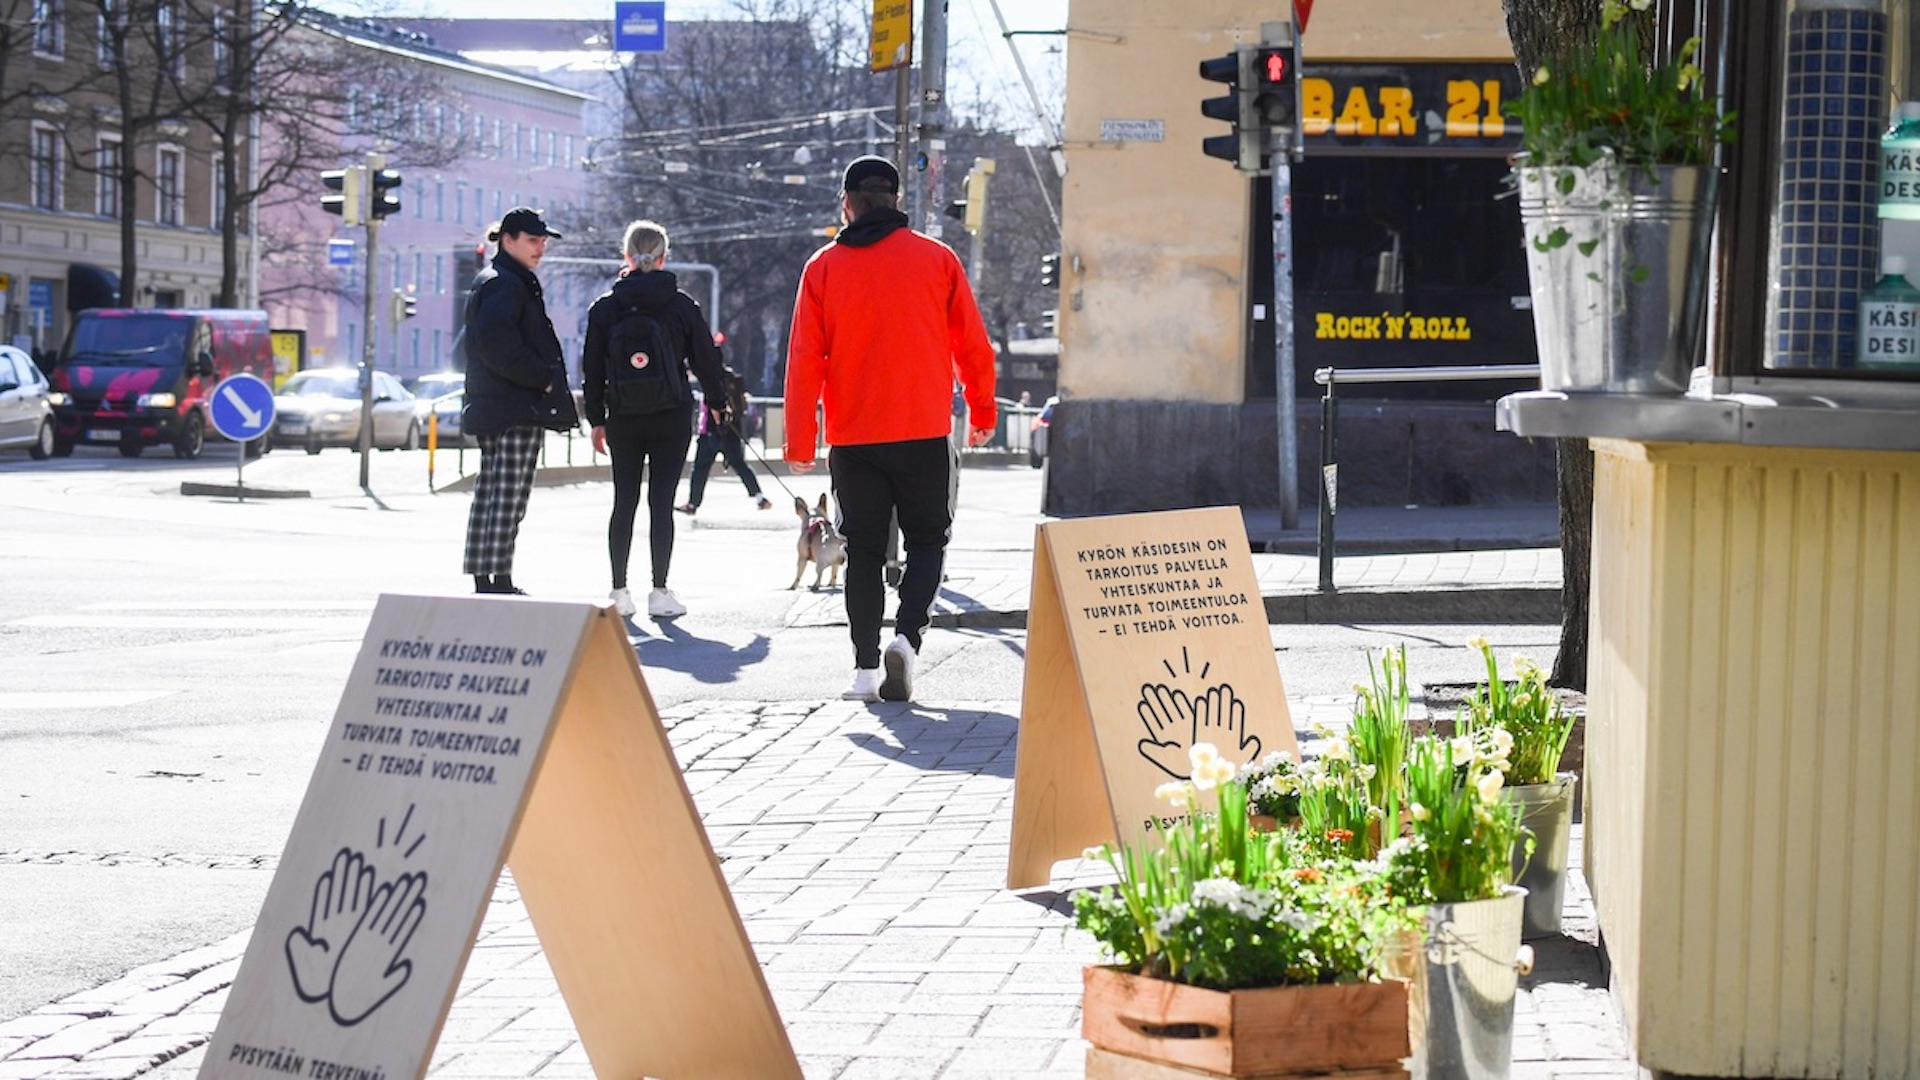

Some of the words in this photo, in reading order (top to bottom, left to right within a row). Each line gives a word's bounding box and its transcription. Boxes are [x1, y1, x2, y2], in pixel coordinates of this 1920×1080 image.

[1302, 78, 1417, 135] BAR
[1446, 80, 1505, 137] 21
[1869, 304, 1916, 328] KÄSI
[1868, 337, 1915, 354] DESI
[1077, 544, 1126, 563] KYRÖN
[1132, 541, 1201, 558] KÄSIDESIN
[1207, 538, 1228, 551] ON
[1085, 563, 1159, 581] TARKOITUS
[1165, 557, 1228, 574] PALVELLA
[1100, 579, 1200, 598] YHTEISKUNTAA
[1207, 576, 1223, 589] JA
[1083, 603, 1142, 620] TURVATA
[1148, 593, 1248, 614] TOIMEENTULOA
[1114, 624, 1127, 636] EI
[1133, 614, 1177, 634] TEHDÄ
[1182, 612, 1244, 629] VOITTOA.
[380, 636, 433, 659] KYRÖN
[436, 638, 516, 665] KÄSIDESIN
[521, 649, 547, 667] ON
[375, 668, 453, 691] TARKOITUS
[457, 674, 530, 696] PALVELLA
[375, 697, 482, 723] YHTEISKUNTAA
[487, 707, 508, 725] JA
[342, 723, 403, 745] TURVATA
[409, 729, 522, 756] TOIMEENTULOA
[356, 753, 373, 772] EI
[377, 754, 427, 777] TEHDÄ
[432, 761, 498, 785] VOITTOA.
[229, 1043, 304, 1074] PYSYTÄÄN
